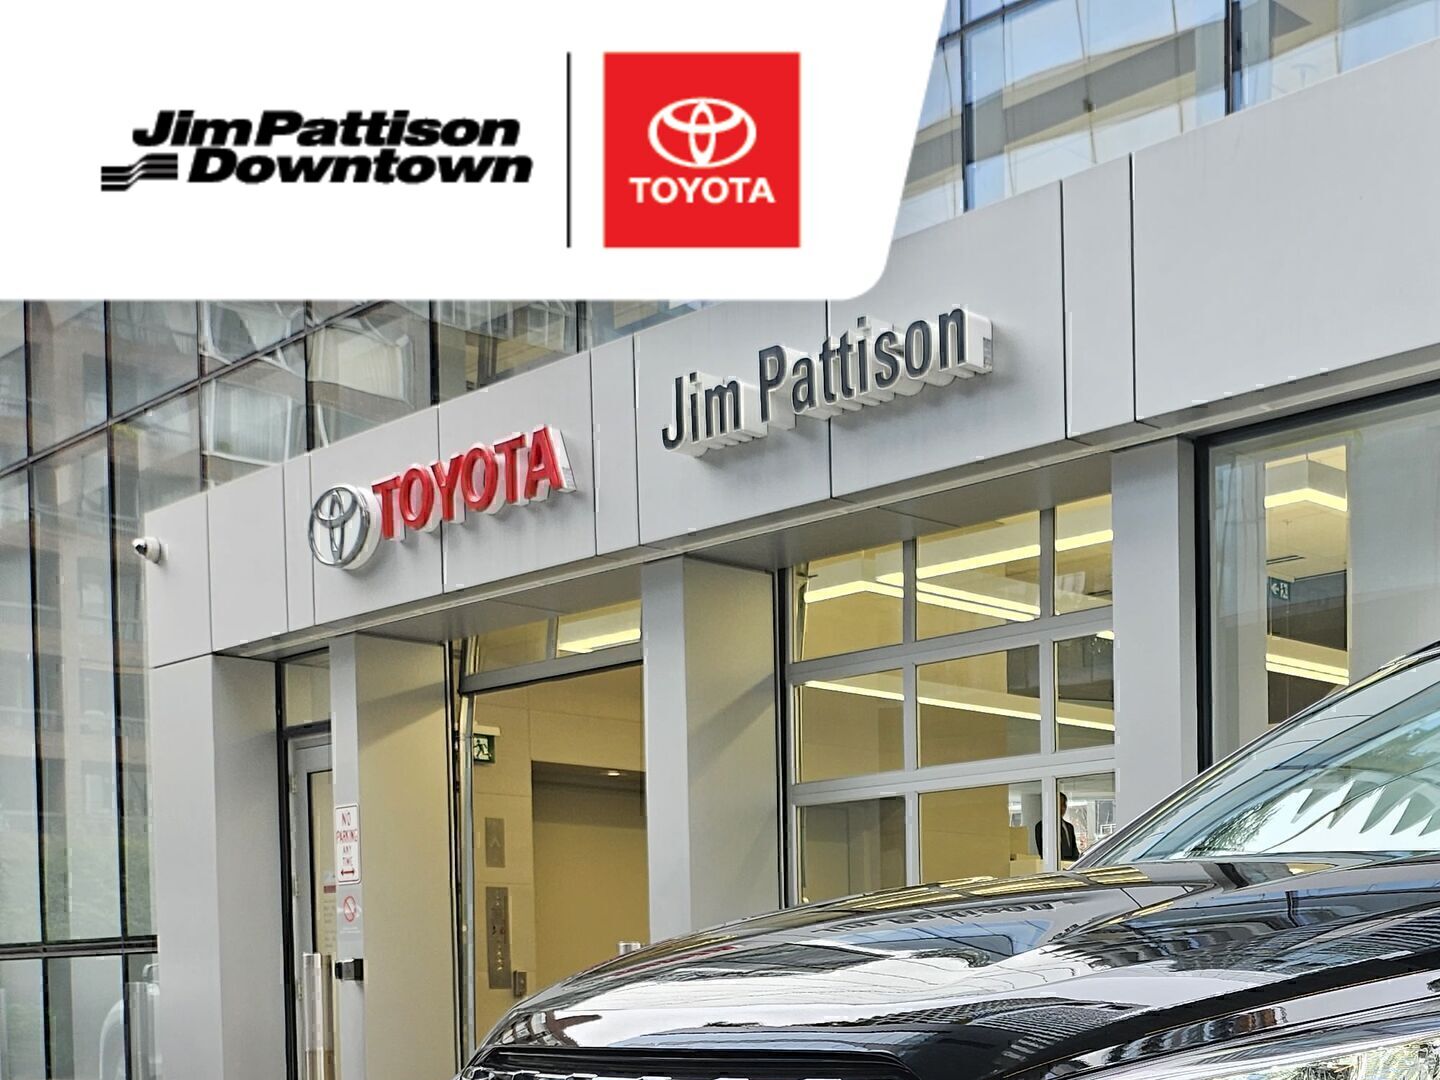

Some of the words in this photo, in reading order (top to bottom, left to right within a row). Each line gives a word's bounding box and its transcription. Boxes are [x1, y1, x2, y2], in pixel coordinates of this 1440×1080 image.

[662, 371, 742, 450] Jim
[758, 308, 968, 423] Pattison
[371, 426, 565, 540] TOYOTA
[341, 811, 352, 827] NO
